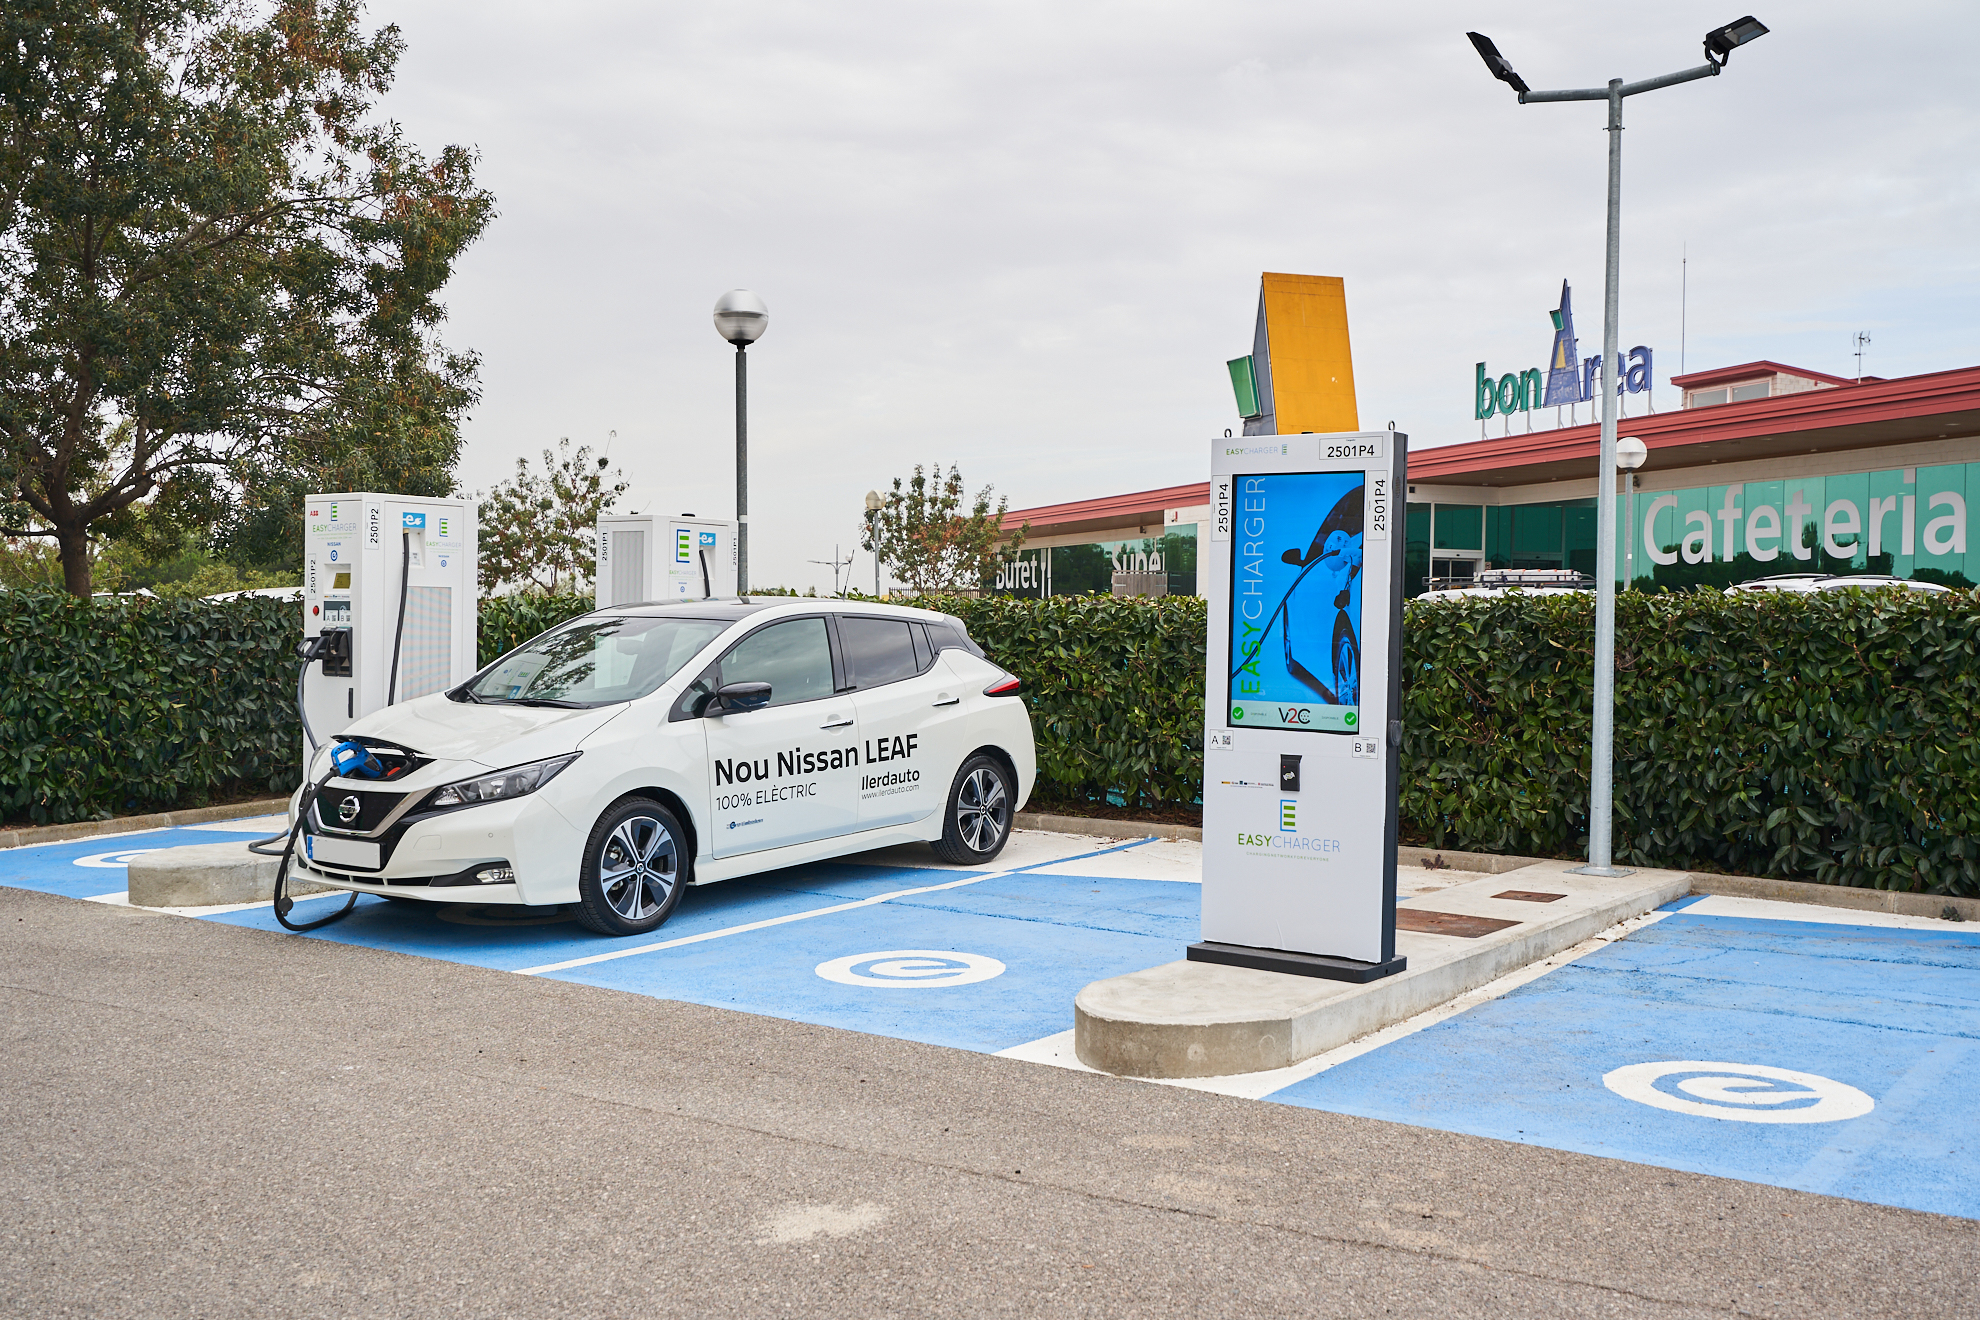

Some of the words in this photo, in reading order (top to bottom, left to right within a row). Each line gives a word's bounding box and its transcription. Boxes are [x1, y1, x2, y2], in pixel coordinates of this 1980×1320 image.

[1226, 446, 1278, 455] EASYCHARGER
[1327, 445, 1375, 458] 2501P4
[1218, 483, 1229, 533] 2501P4
[1374, 479, 1386, 531] 2501P4
[1643, 468, 1967, 566] Cafeteria
[312, 523, 357, 533] EASYCHARGER
[370, 508, 379, 544] 2501P2
[1241, 478, 1266, 694] EASYCHARGER
[1278, 707, 1311, 724] V2C
[1211, 735, 1219, 744] A
[1354, 742, 1361, 752] B
[715, 757, 769, 786] Nou
[777, 747, 859, 778] Nissan
[865, 733, 919, 764] LEAF
[716, 792, 752, 811] 100%
[756, 782, 817, 805] ELÈCTRIC
[1238, 833, 1341, 852] EASYCHARGER
